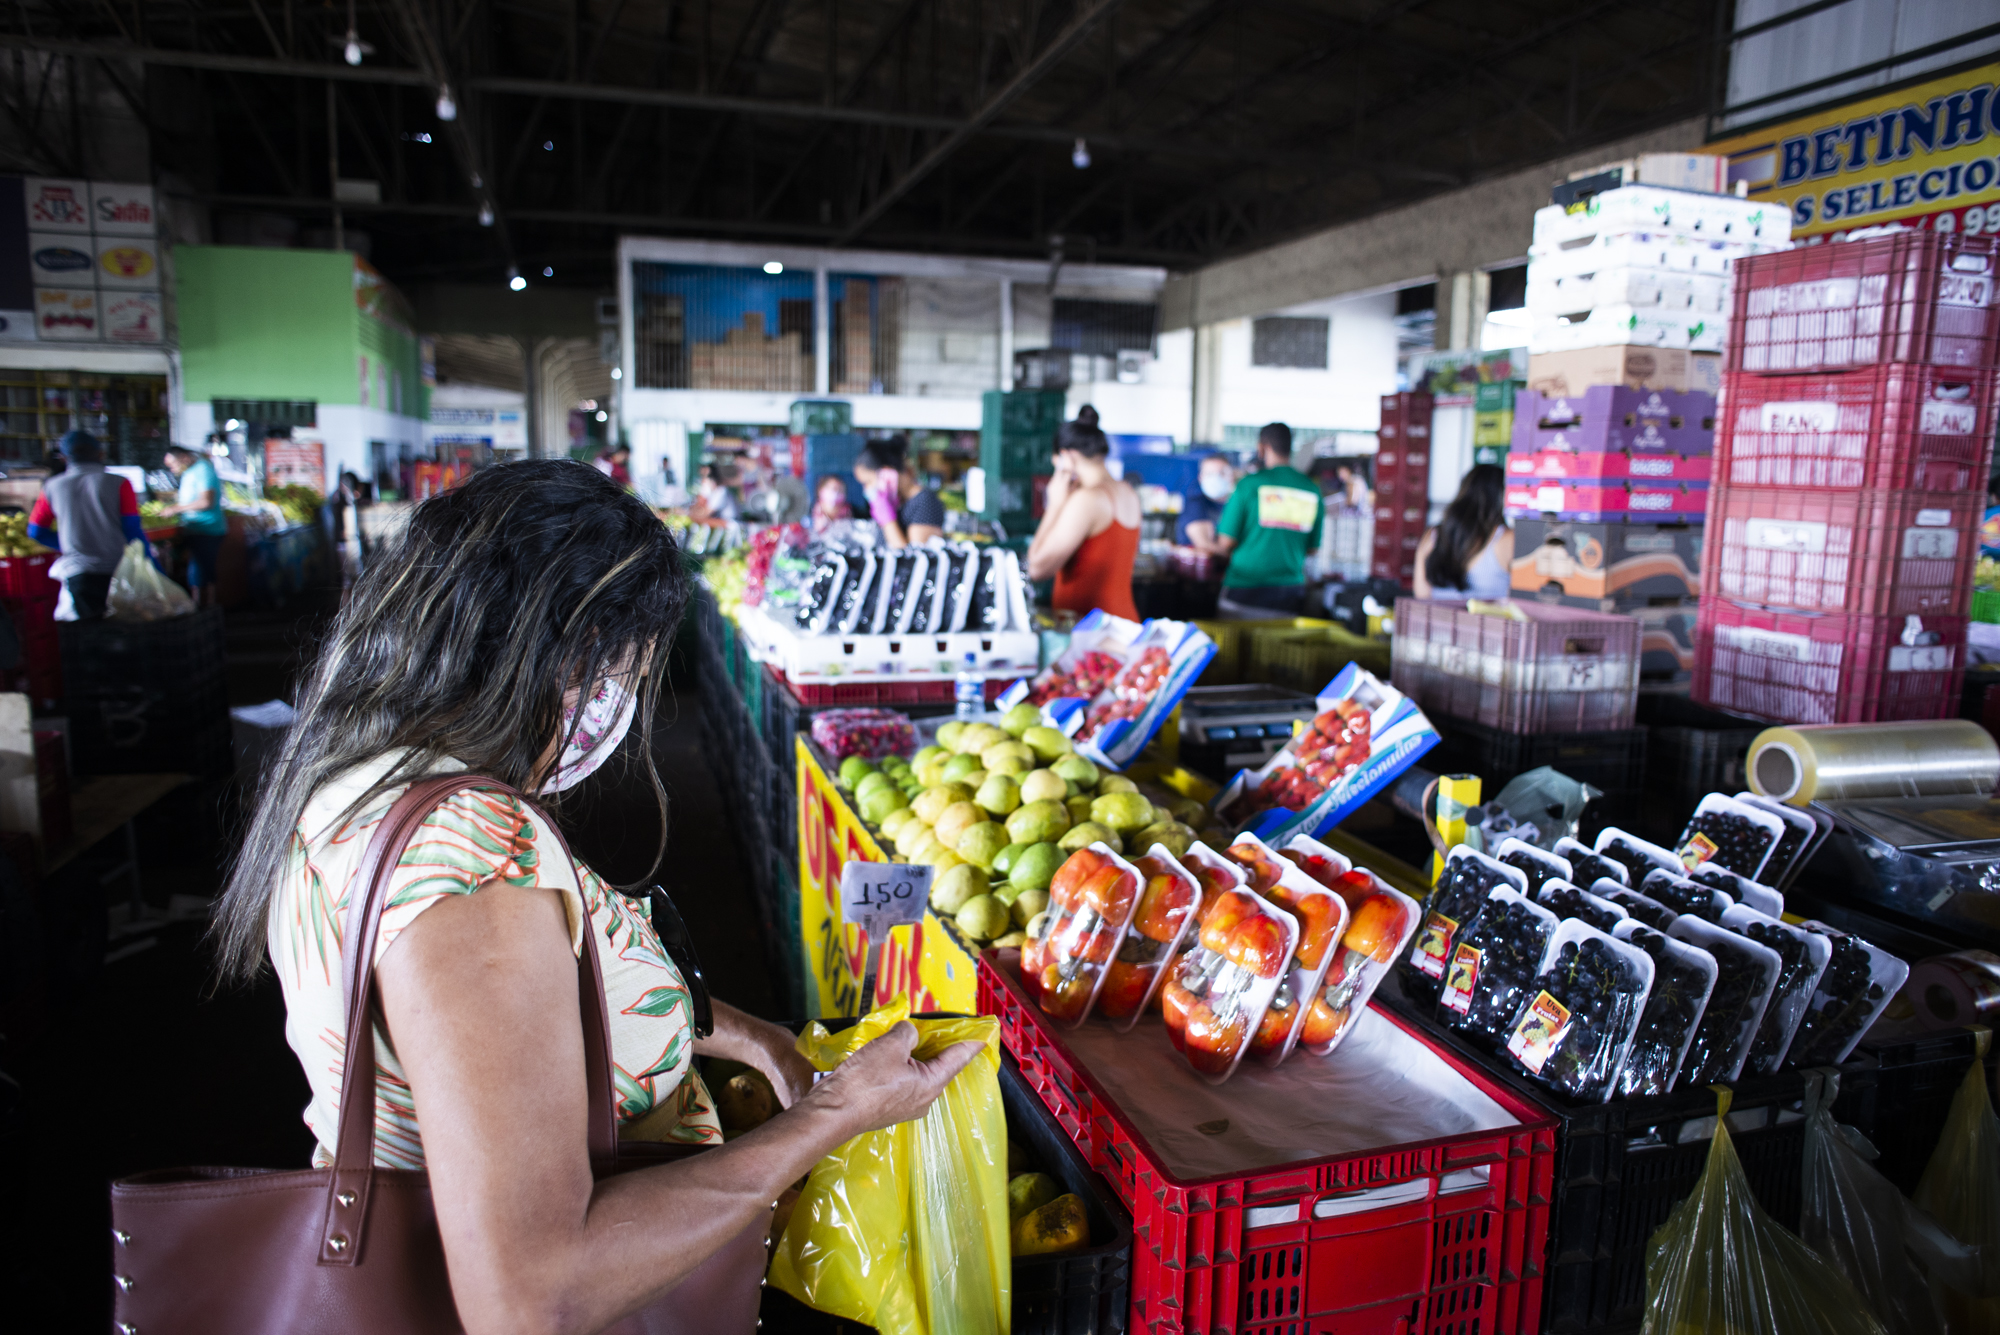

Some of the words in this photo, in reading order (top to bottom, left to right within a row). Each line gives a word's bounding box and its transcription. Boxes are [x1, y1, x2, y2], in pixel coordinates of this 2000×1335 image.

[1780, 84, 2000, 186] BETINH
[1821, 155, 2000, 221] SELECIO
[852, 881, 914, 912] 1,50
[1535, 1006, 1561, 1023] Frutas
[1545, 998, 1562, 1017] Uva
